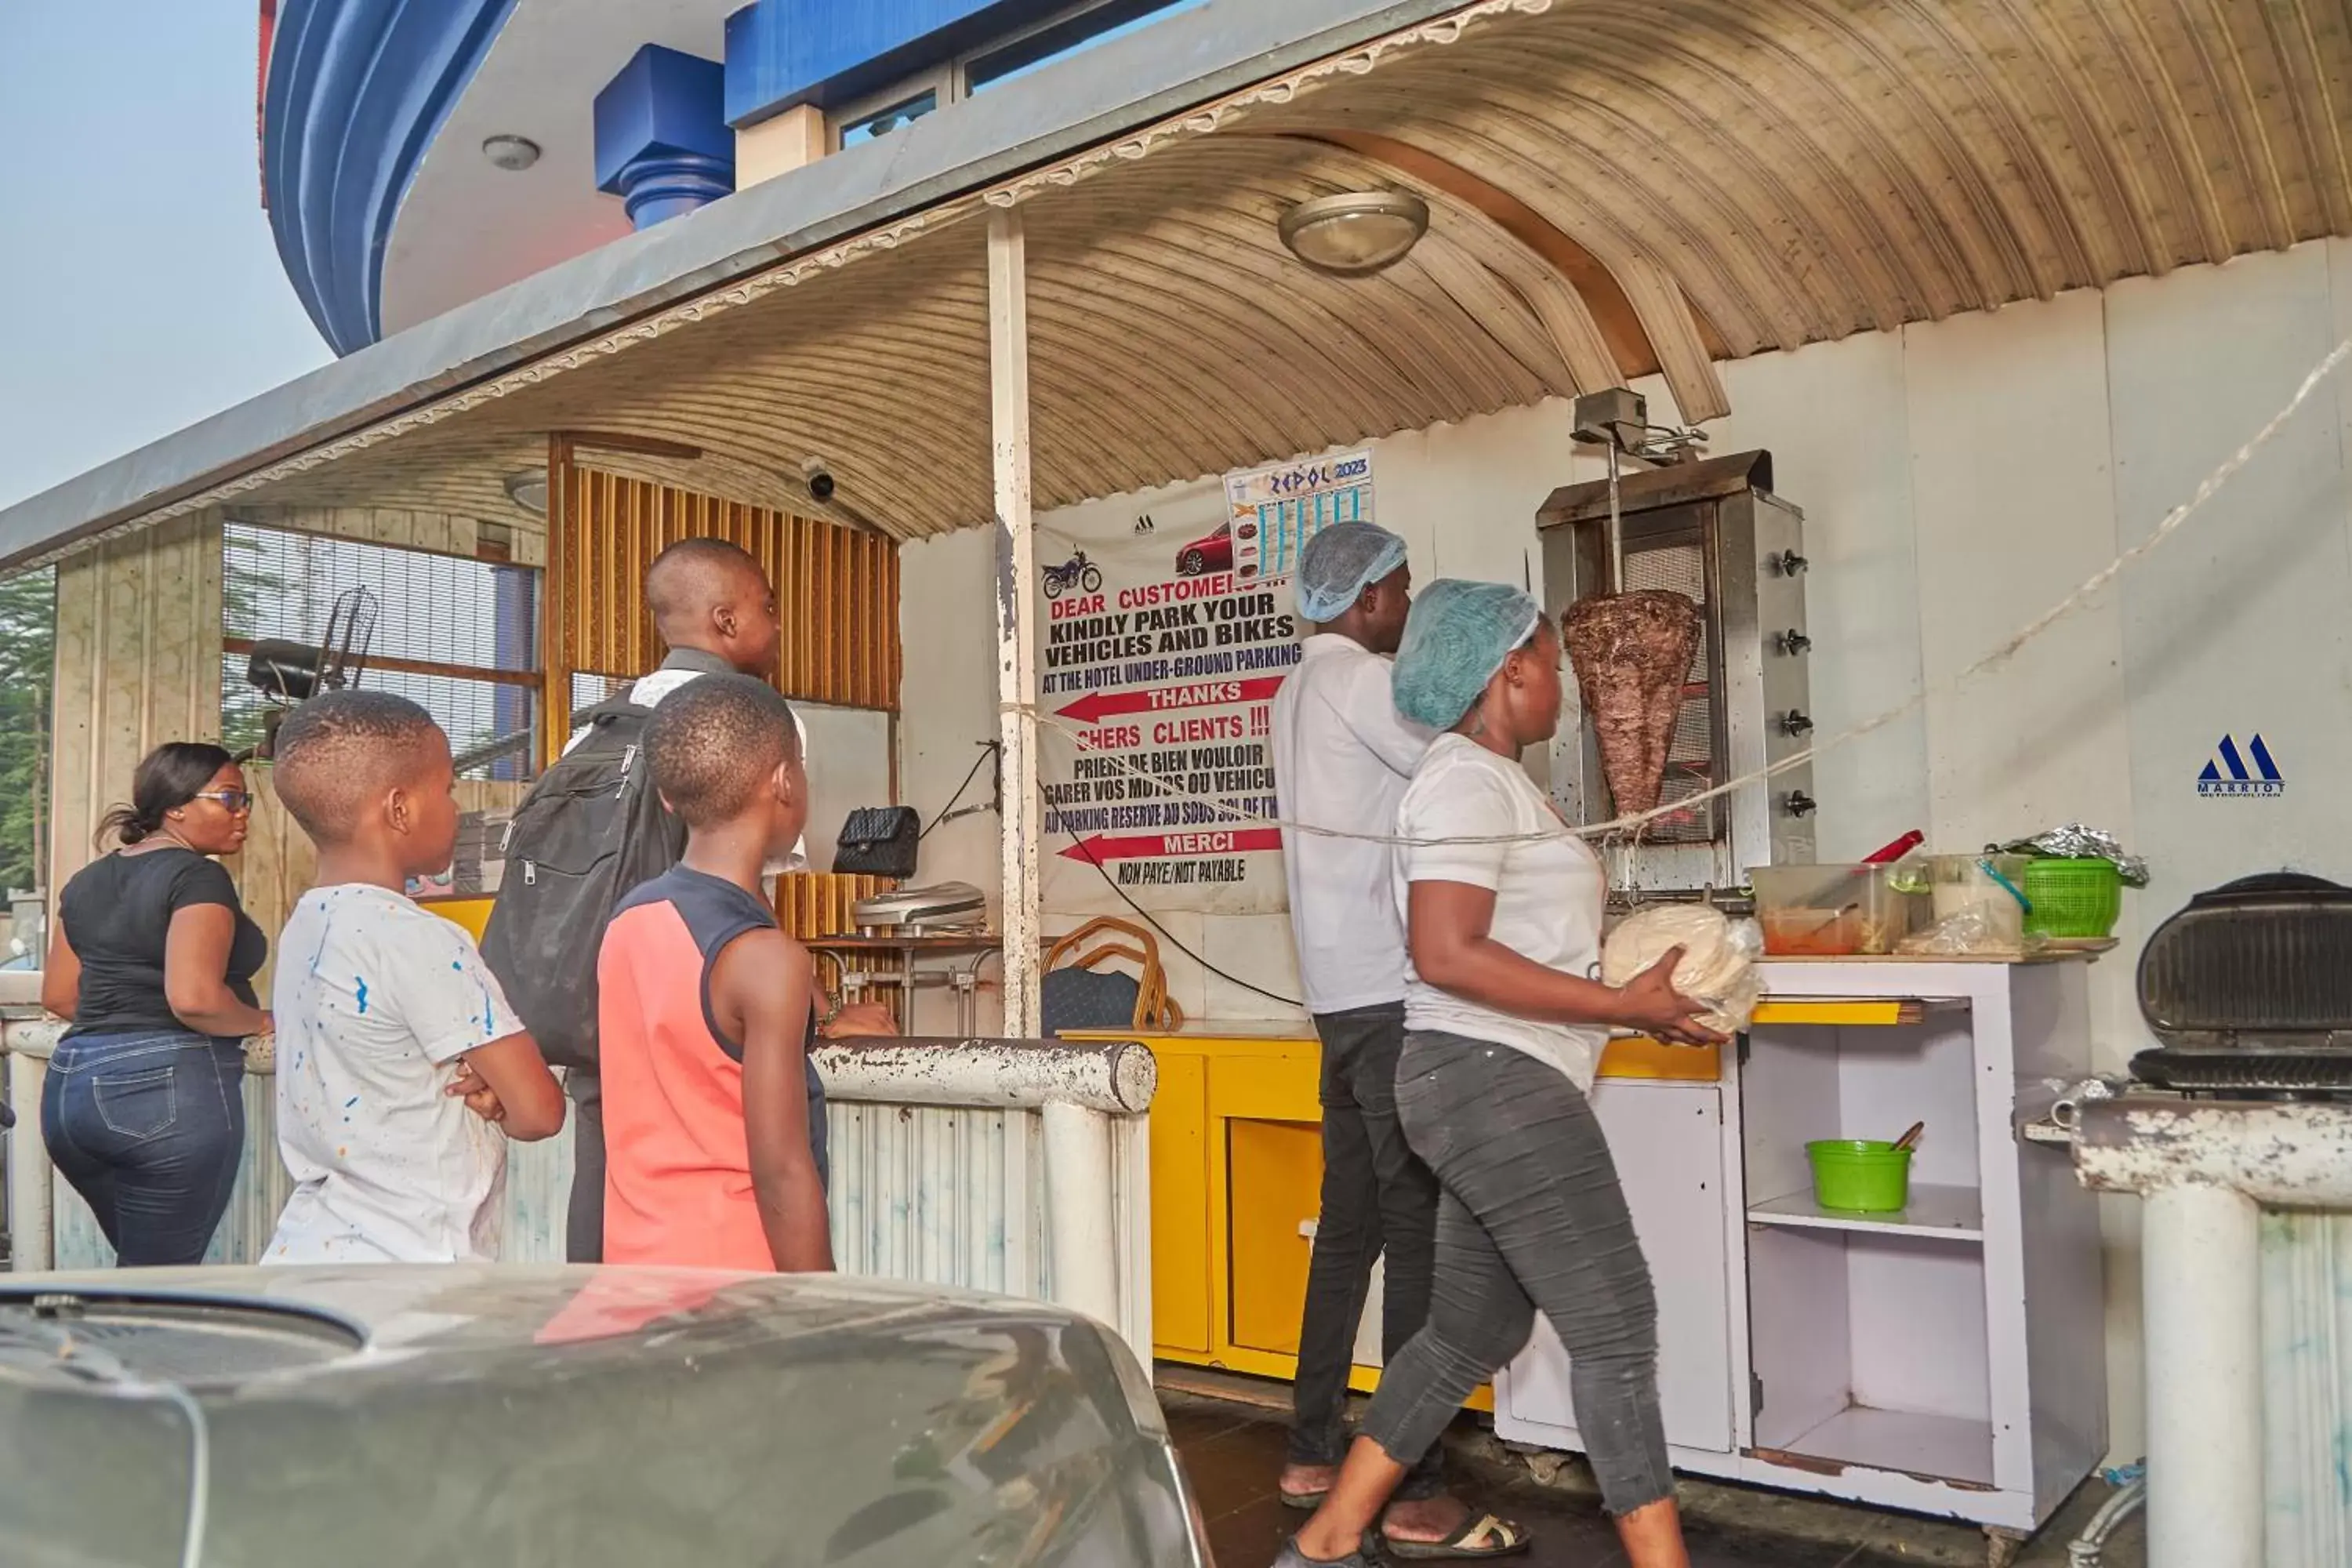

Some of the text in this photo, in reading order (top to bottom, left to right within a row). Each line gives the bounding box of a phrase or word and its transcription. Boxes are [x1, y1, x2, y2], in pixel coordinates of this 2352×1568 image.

[1335, 459, 1367, 477] 2023
[1050, 593, 1274, 644] KINDLY PARK YOUR
[1051, 593, 1105, 619] DEAR
[1045, 615, 1294, 666] VEHICLES AND BIKES
[1043, 643, 1302, 694] AT THE HOTEL UNDER-GROUND PARKING
[1148, 682, 1241, 709] THANKS
[1076, 706, 1269, 751] CHERS CLIENTS !!!
[1074, 744, 1263, 779] PRIERE DE BIEN VOULOIR
[1044, 782, 1091, 805] GARER
[1094, 779, 1125, 800] VOS
[1129, 774, 1185, 798] MOTOS
[1188, 772, 1210, 794] OU
[2198, 783, 2285, 793] MARRIOT
[1044, 811, 1059, 833] AU
[1062, 807, 1109, 833] PARKING
[1112, 804, 1161, 829] RESERVE
[1163, 802, 1180, 826] AU
[1182, 800, 1215, 824] SOUS
[1163, 833, 1234, 854] MERCI
[1118, 862, 1142, 885] NON
[1198, 859, 1245, 883] PAYABLE
